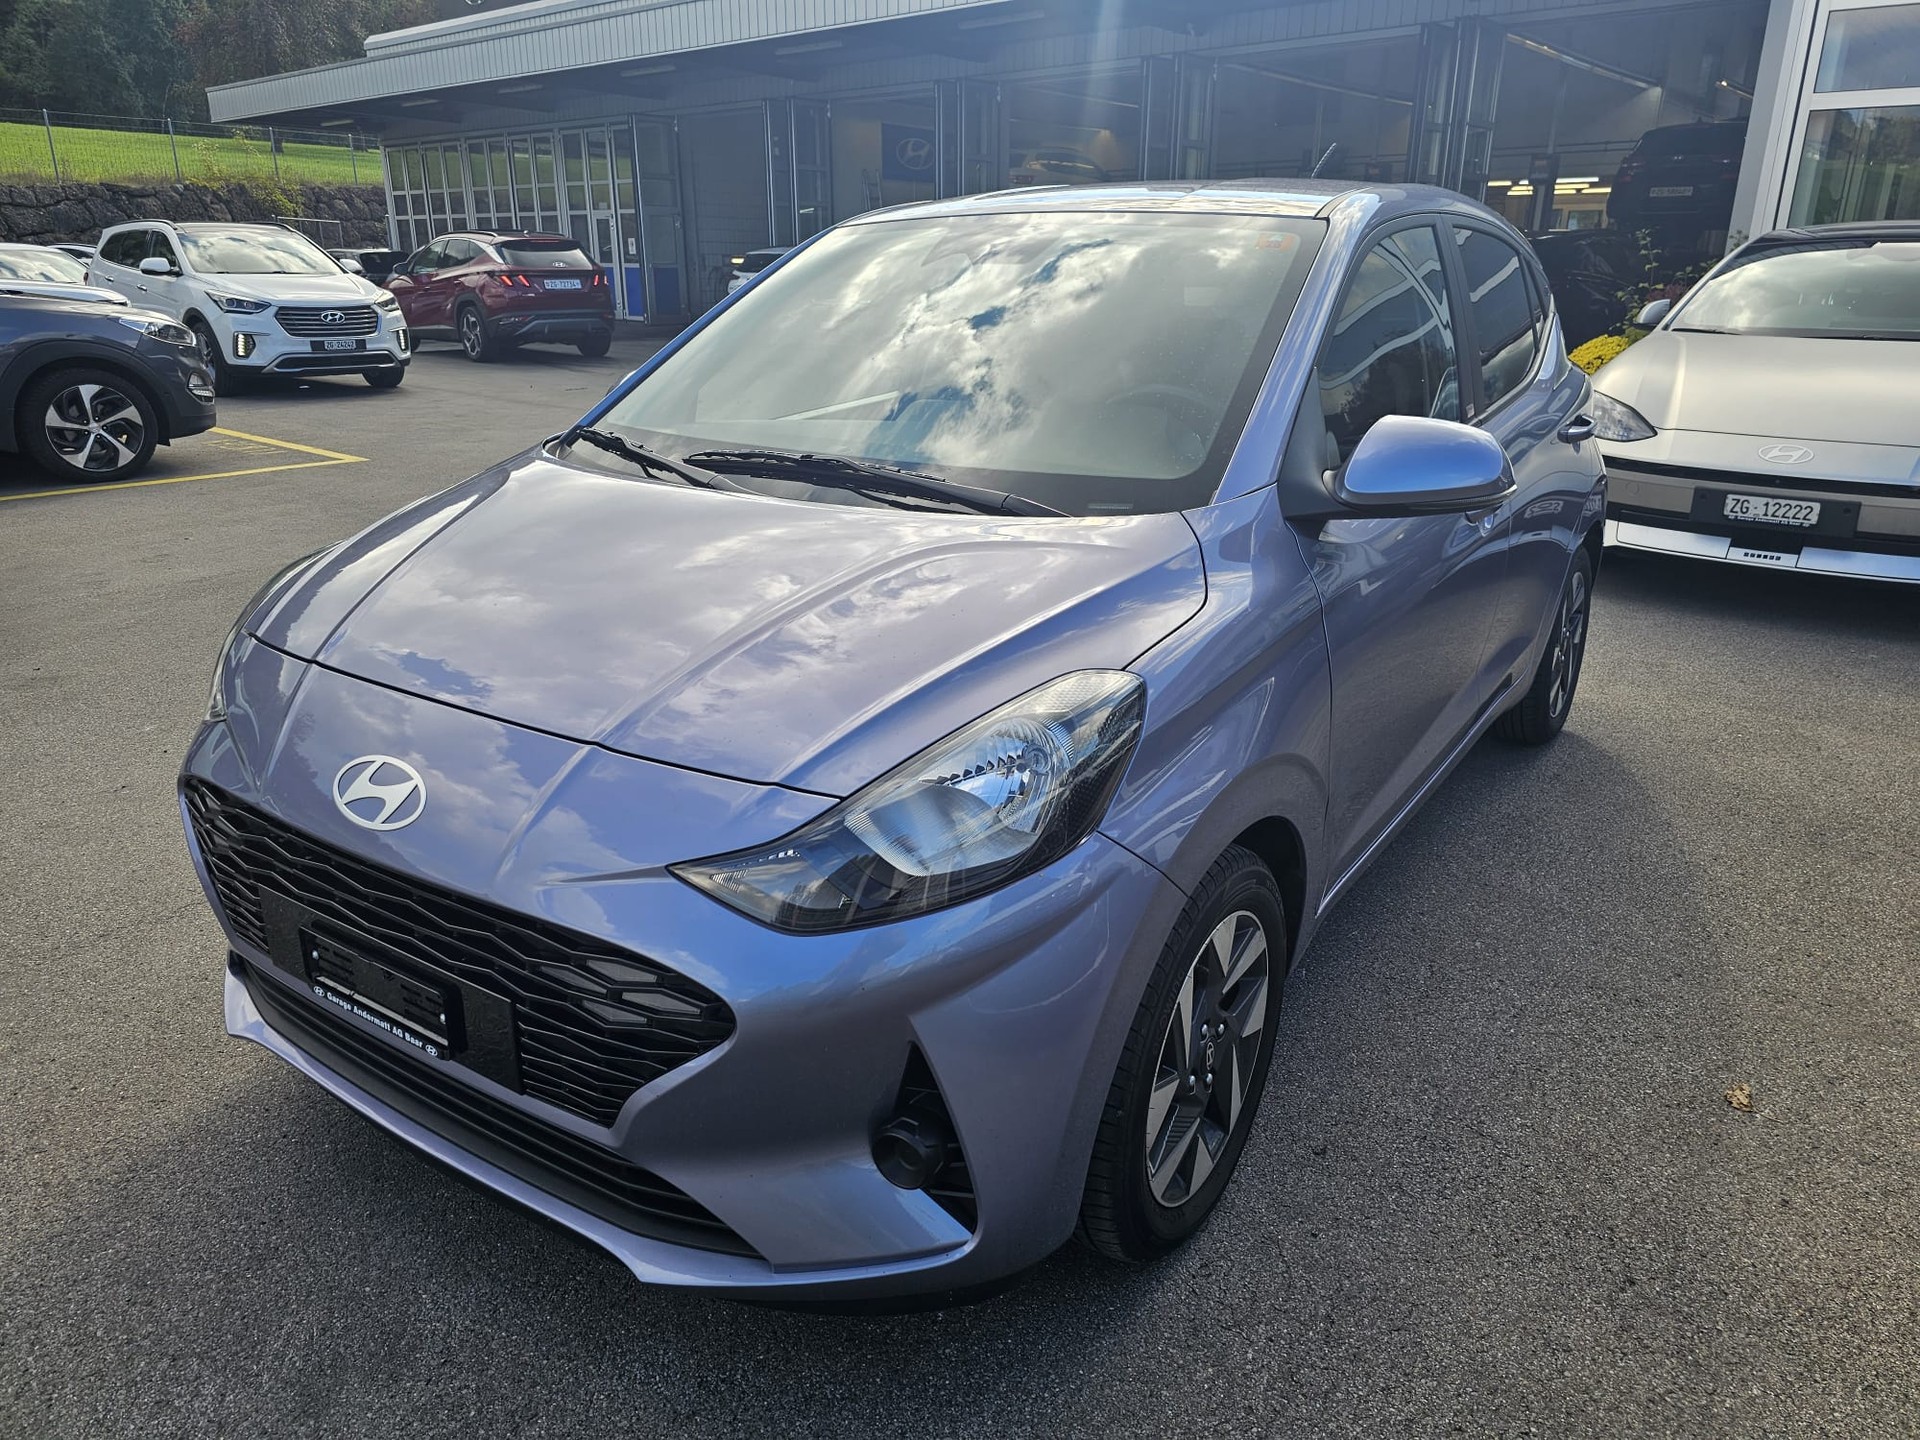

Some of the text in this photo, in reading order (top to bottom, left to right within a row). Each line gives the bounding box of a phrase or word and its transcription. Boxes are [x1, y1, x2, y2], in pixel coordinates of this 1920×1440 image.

[326, 991, 423, 1048] Garage Andermatt AG Baar
